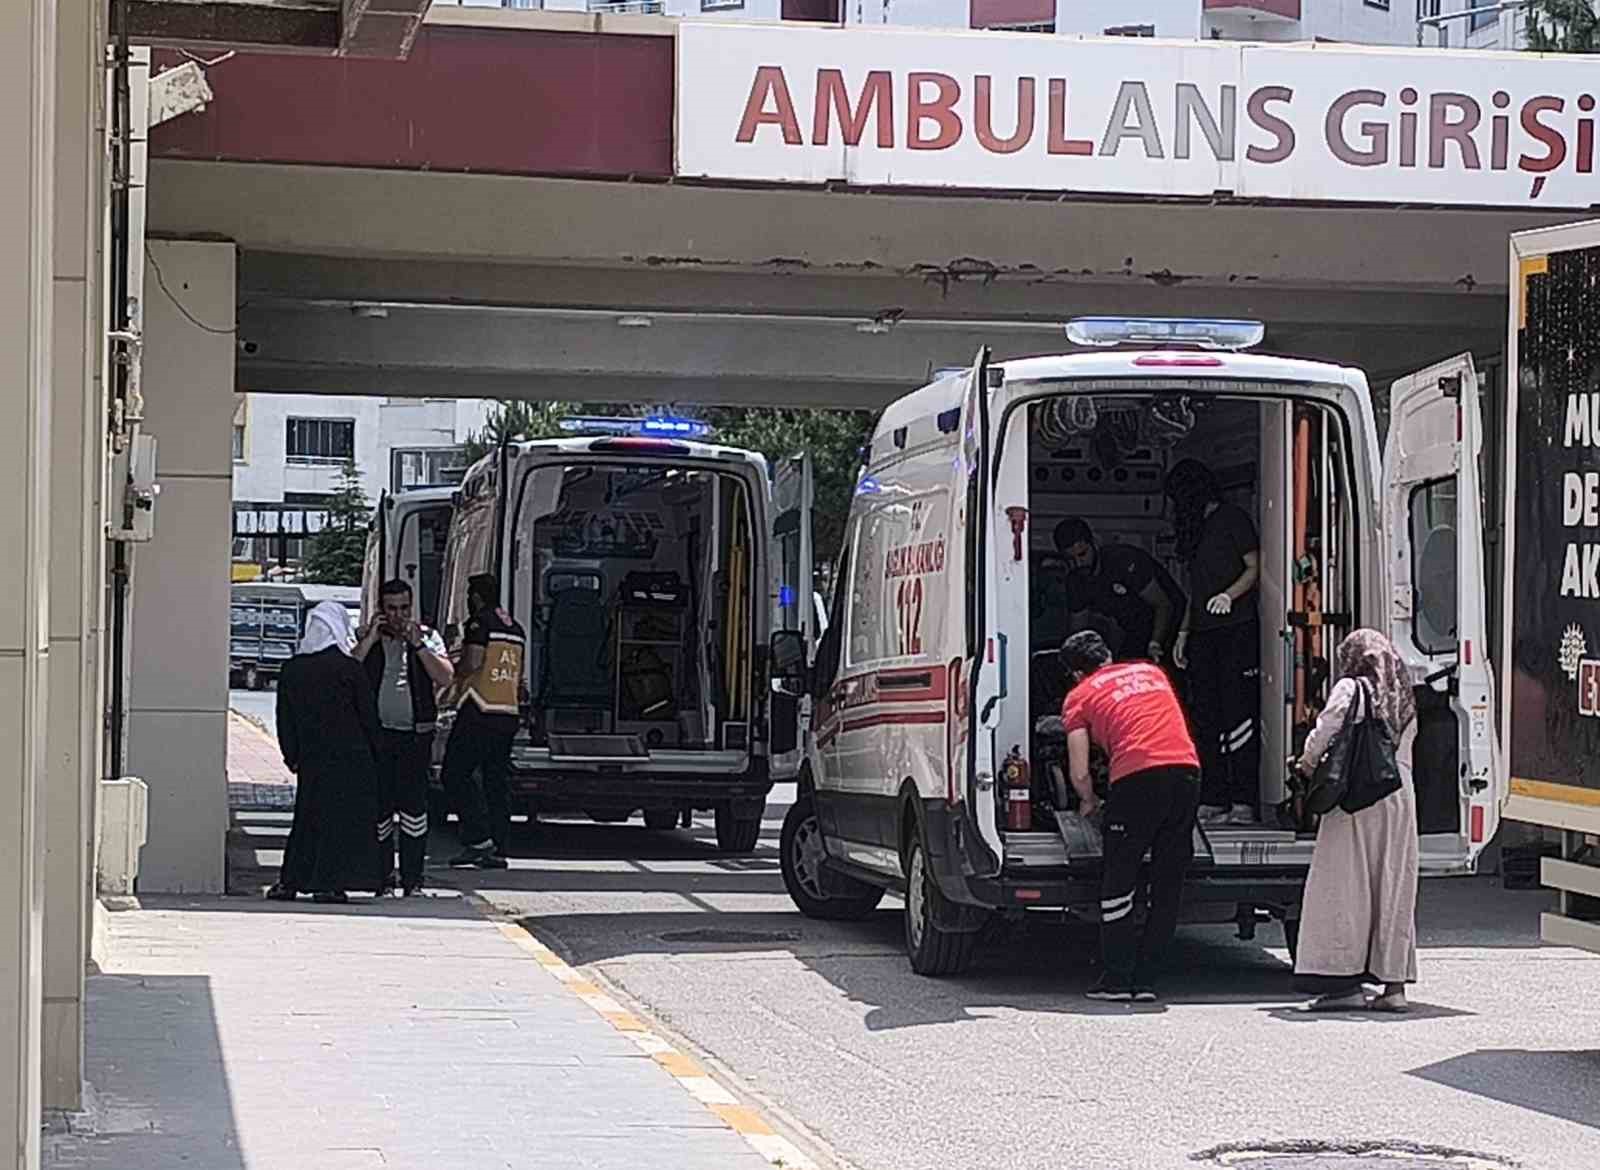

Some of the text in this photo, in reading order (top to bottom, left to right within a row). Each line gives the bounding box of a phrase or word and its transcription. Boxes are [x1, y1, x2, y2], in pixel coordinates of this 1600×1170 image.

[735, 65, 1297, 164] AMBULANS
[897, 577, 922, 655] 112
[1579, 660, 1600, 716] E
